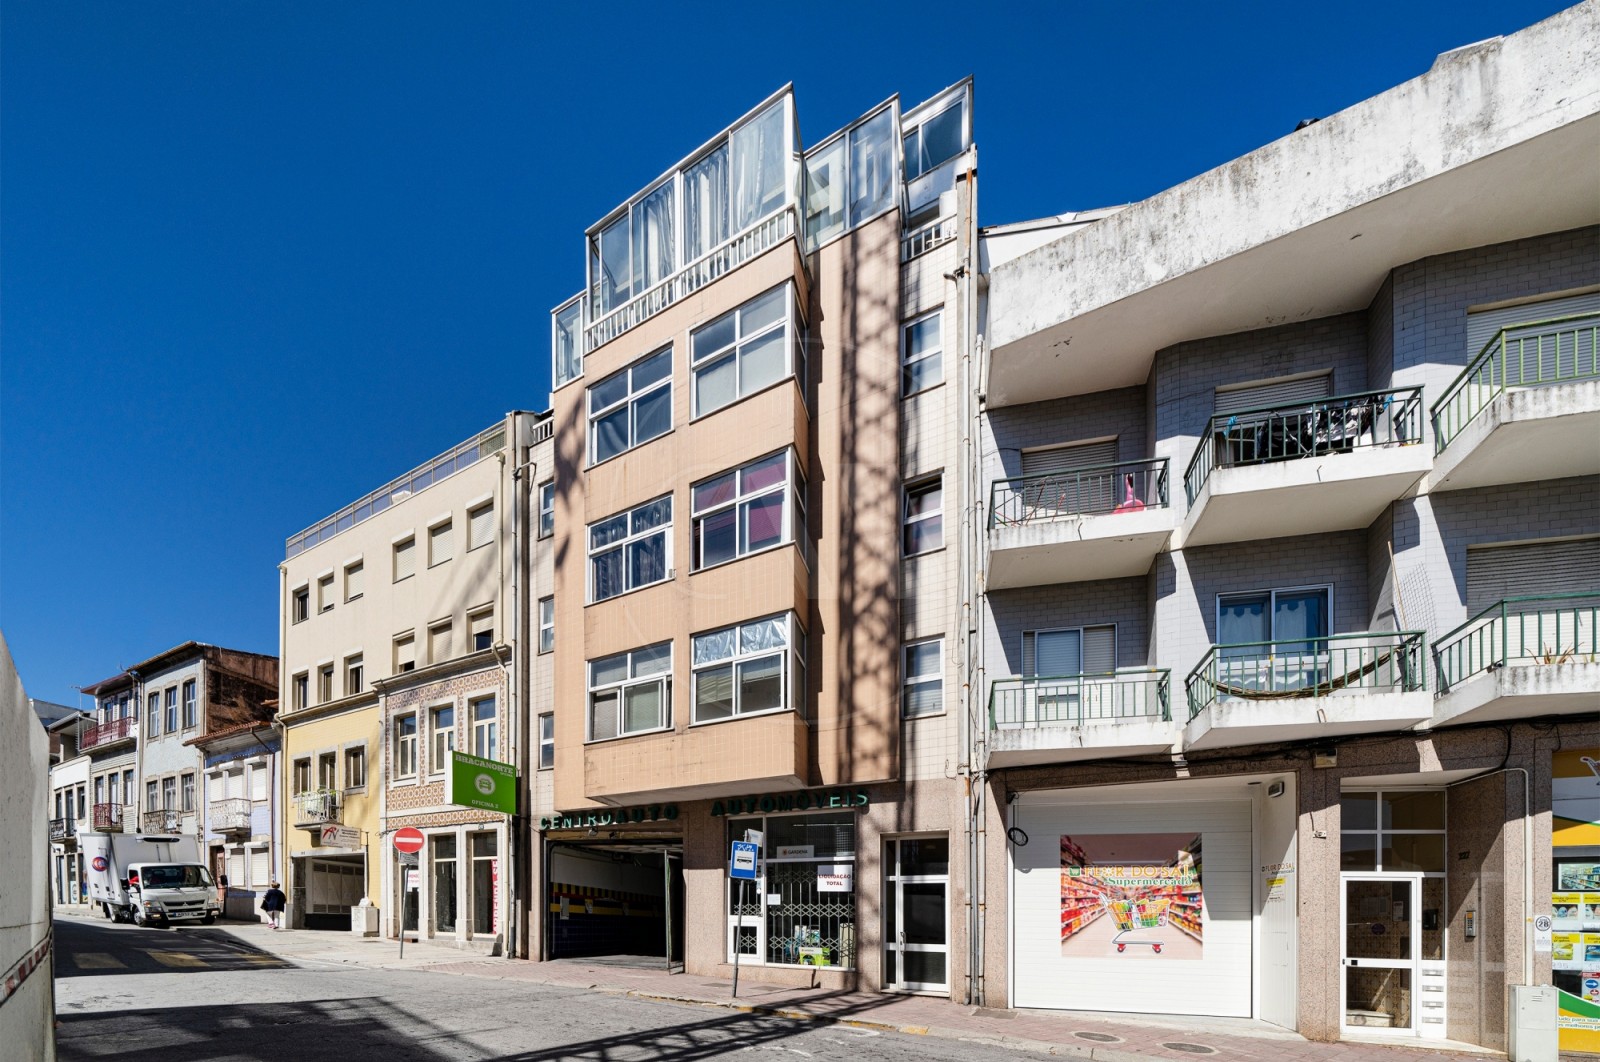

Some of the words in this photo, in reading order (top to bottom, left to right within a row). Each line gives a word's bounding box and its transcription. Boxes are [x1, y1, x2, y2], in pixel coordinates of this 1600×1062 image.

[472, 800, 494, 808] OFICINA
[1084, 865, 1124, 877] FLOR
[1131, 865, 1157, 877] DO
[1106, 876, 1193, 887] Supermercado
[1538, 920, 1549, 928] 28
